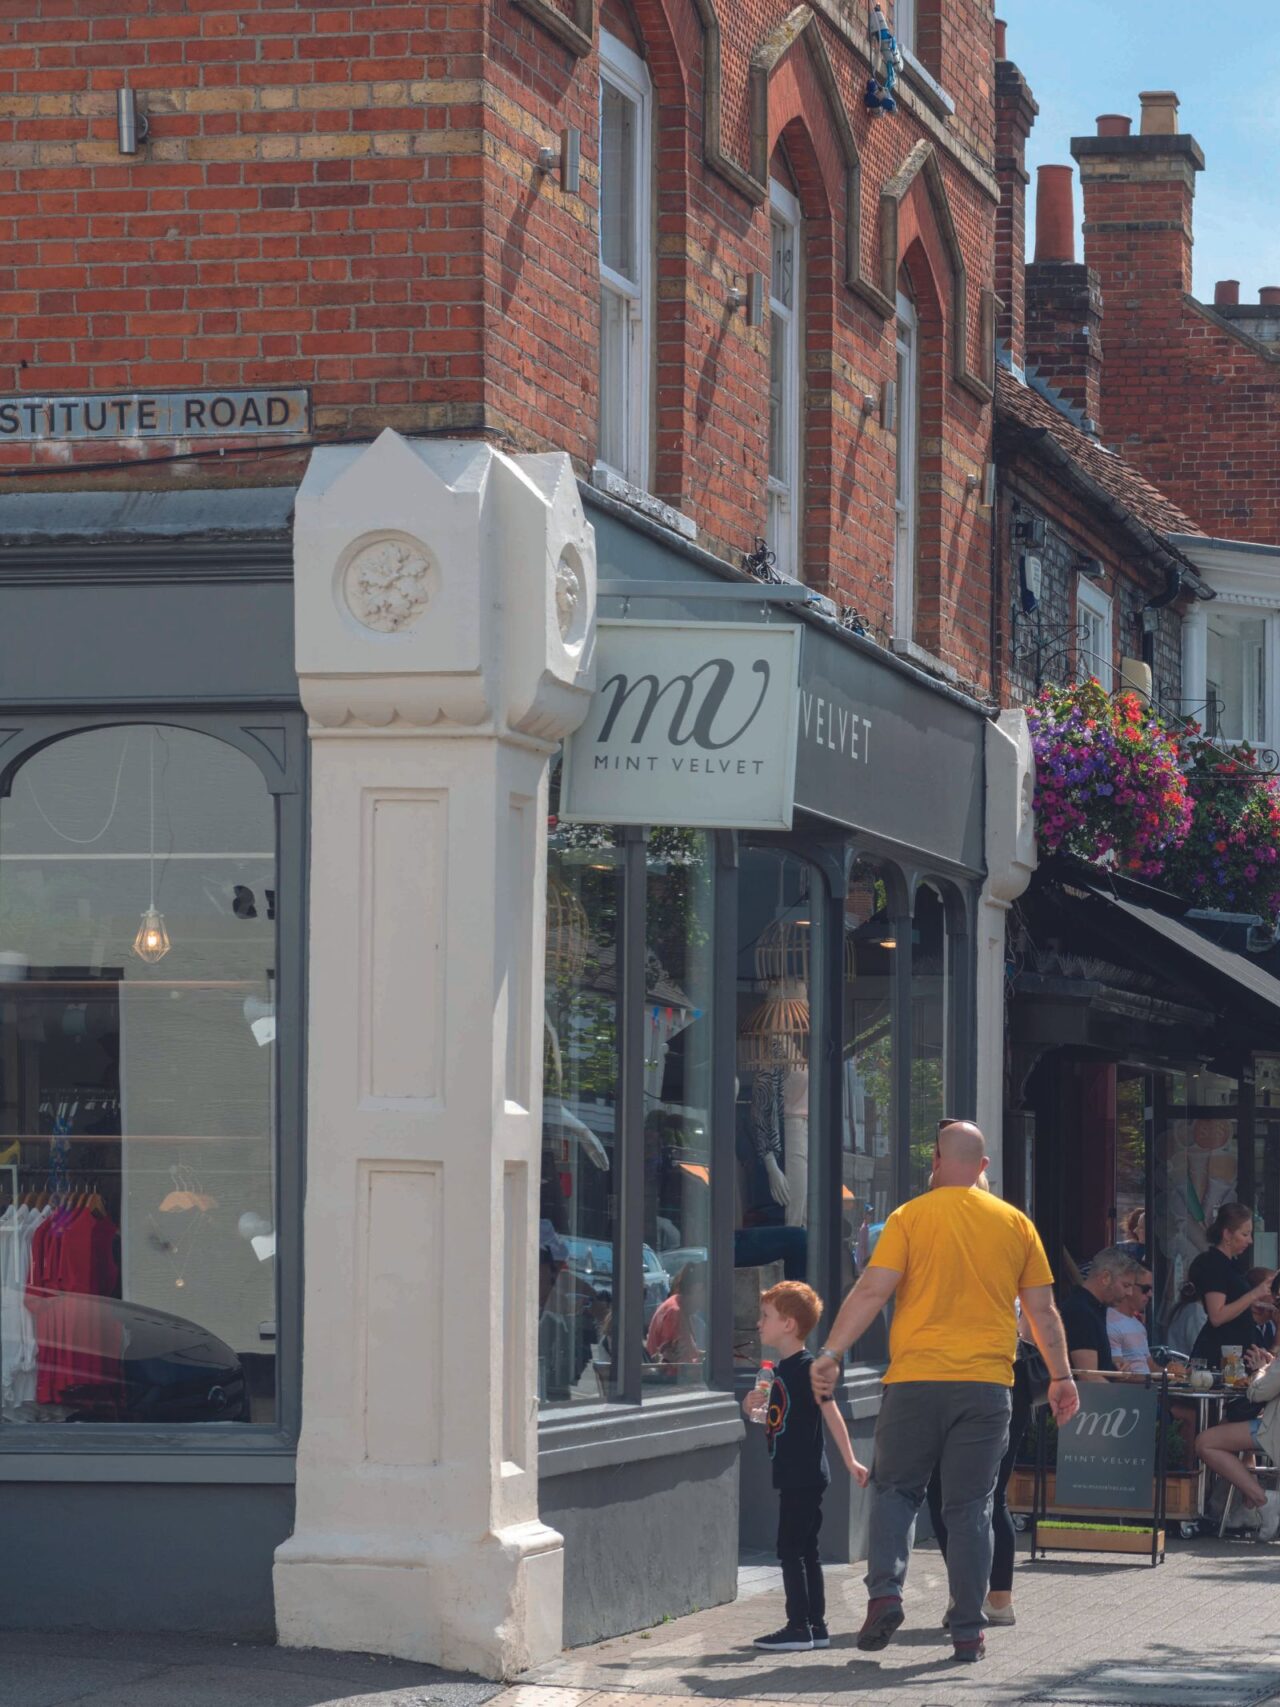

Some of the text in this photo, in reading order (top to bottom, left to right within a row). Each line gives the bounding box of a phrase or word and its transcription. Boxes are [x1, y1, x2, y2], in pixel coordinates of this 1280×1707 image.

[0, 397, 290, 434] STITUTE ROAD
[802, 690, 872, 764] VELVET
[594, 755, 764, 774] MINT VELVET
[1064, 1455, 1147, 1466] MINT VELVET
